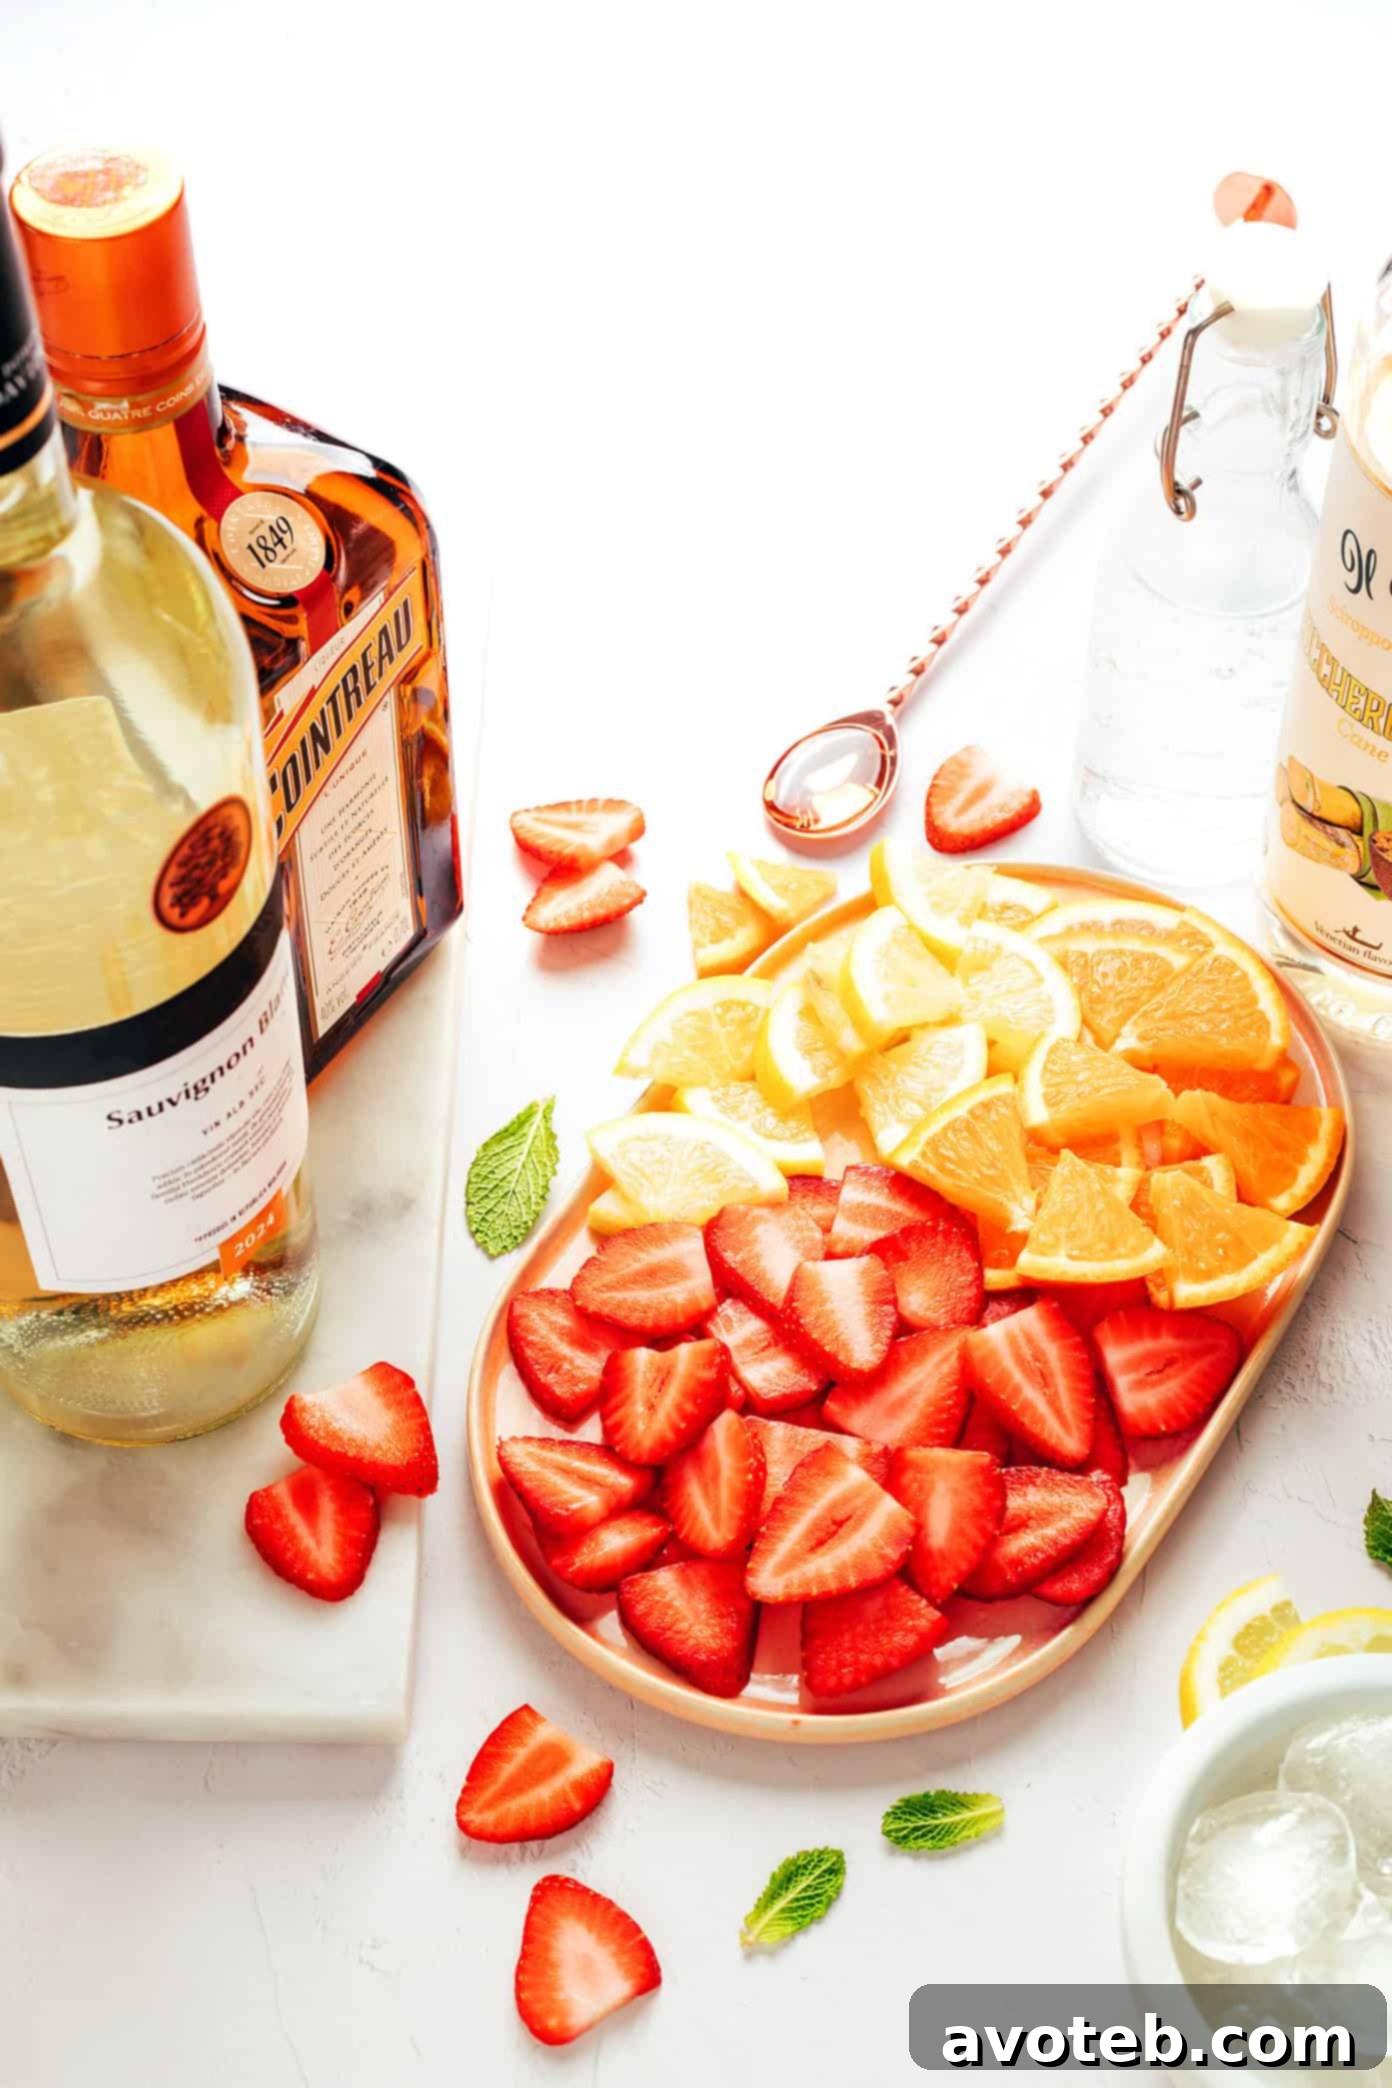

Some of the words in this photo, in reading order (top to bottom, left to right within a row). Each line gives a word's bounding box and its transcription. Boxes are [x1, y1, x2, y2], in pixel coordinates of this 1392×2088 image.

[88, 405, 153, 422] QUATRE
[155, 382, 195, 413] COINS
[246, 515, 294, 570] 1849
[1336, 715, 1389, 764] Cane
[1313, 919, 1361, 956] Venetian
[105, 1034, 256, 1131] Sauvignon
[233, 1211, 275, 1259] 2024
